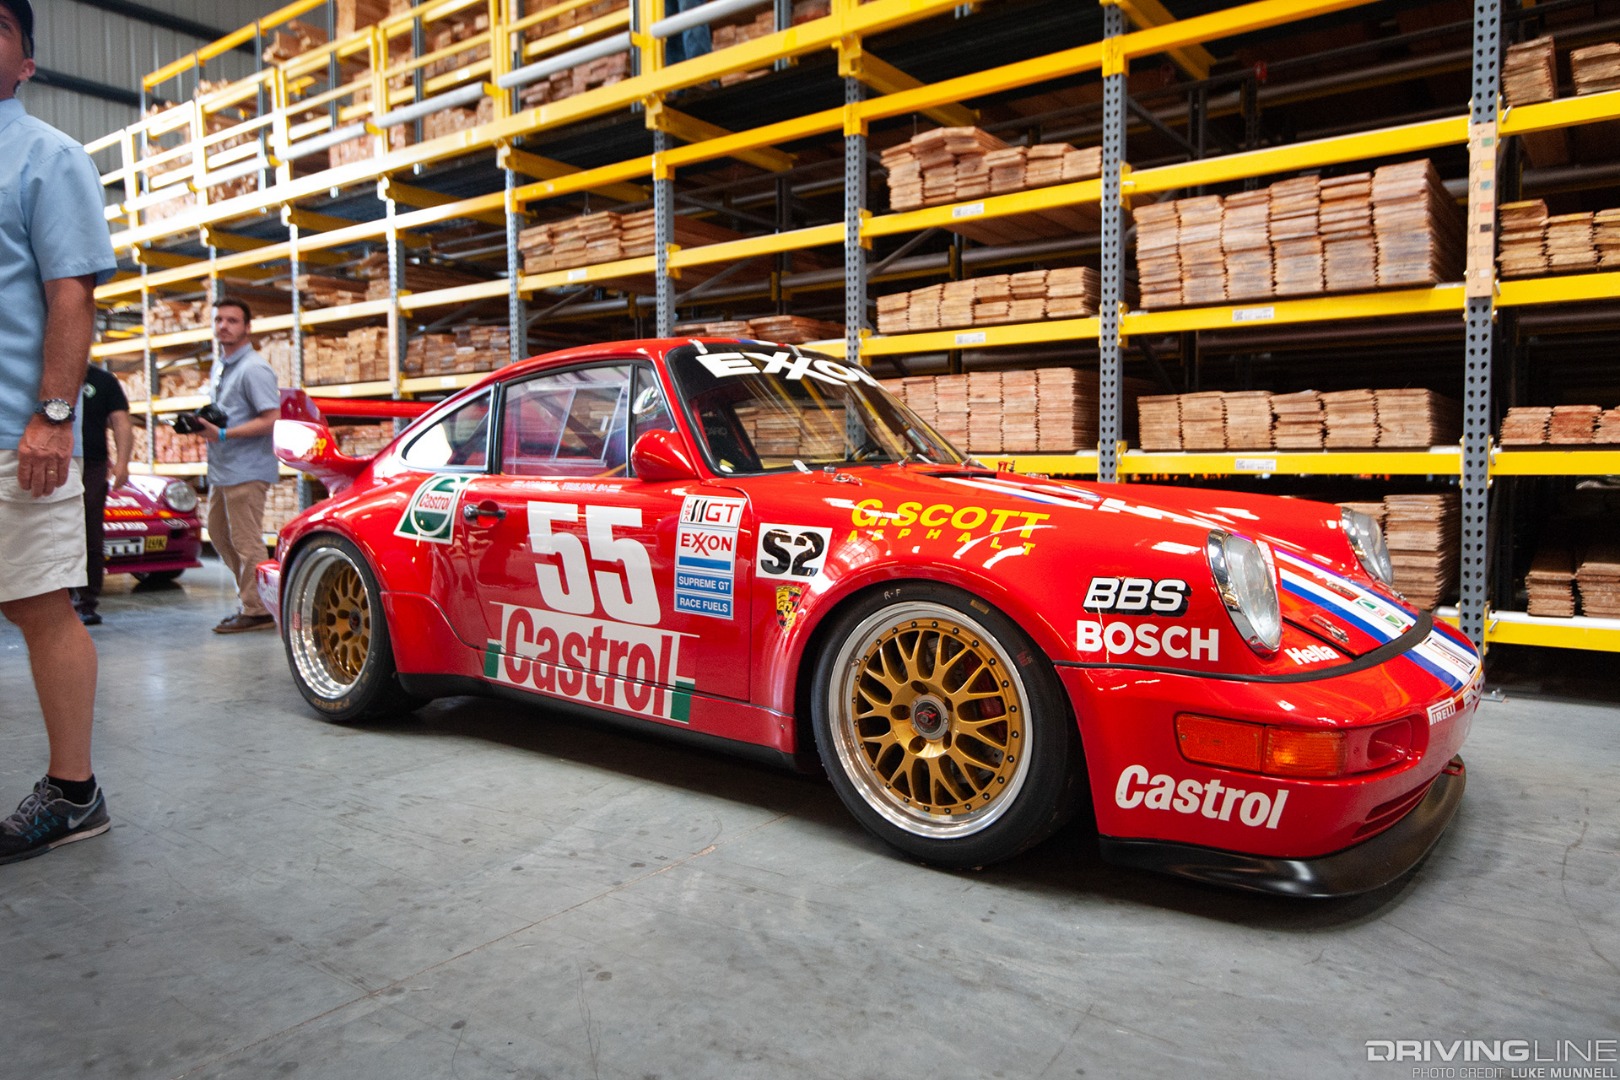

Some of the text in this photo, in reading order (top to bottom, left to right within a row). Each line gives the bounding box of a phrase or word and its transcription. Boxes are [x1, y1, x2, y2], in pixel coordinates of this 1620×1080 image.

[419, 493, 453, 511] Castrol
[705, 503, 740, 523] GT
[851, 499, 1050, 539] G.SCOTT
[681, 531, 732, 556] EXXON
[760, 529, 825, 577] S2
[846, 528, 1036, 556] ASPHALT
[527, 500, 662, 626] 55
[678, 574, 730, 592] SUPREME GT
[1083, 577, 1191, 616] BBS
[680, 597, 729, 614] RACE FUELS
[1077, 620, 1219, 662] BOSCH
[1286, 641, 1338, 666] Hella
[503, 607, 674, 717] Castrol
[1114, 764, 1289, 829] Castrol
